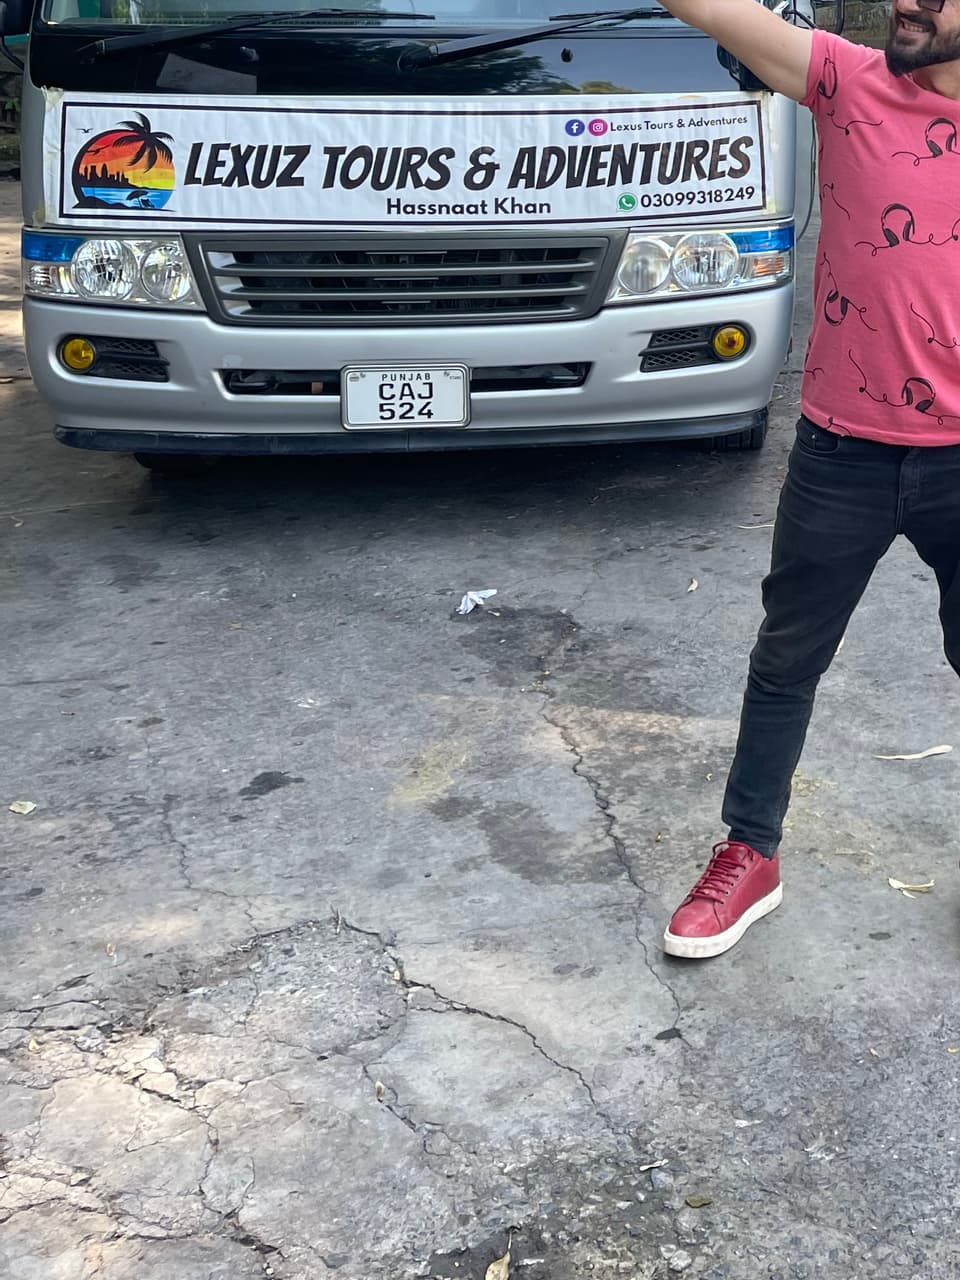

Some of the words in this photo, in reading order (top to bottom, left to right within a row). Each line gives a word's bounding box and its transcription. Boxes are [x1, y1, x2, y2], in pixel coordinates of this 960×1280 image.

[610, 121, 642, 133] Lexus
[645, 119, 673, 131] Tours
[676, 119, 685, 129] &
[688, 115, 747, 128] Adventures
[184, 142, 311, 189] LEXUZ
[322, 145, 455, 191] TOURS
[463, 146, 500, 191] &
[507, 135, 754, 190] ADVENTURES
[387, 198, 488, 215] Hassnaat
[494, 197, 551, 215] Khan
[640, 186, 755, 209] 03099318249
[381, 372, 431, 382] PUNJAB
[379, 382, 434, 401] CAJ
[379, 402, 434, 421] 524
